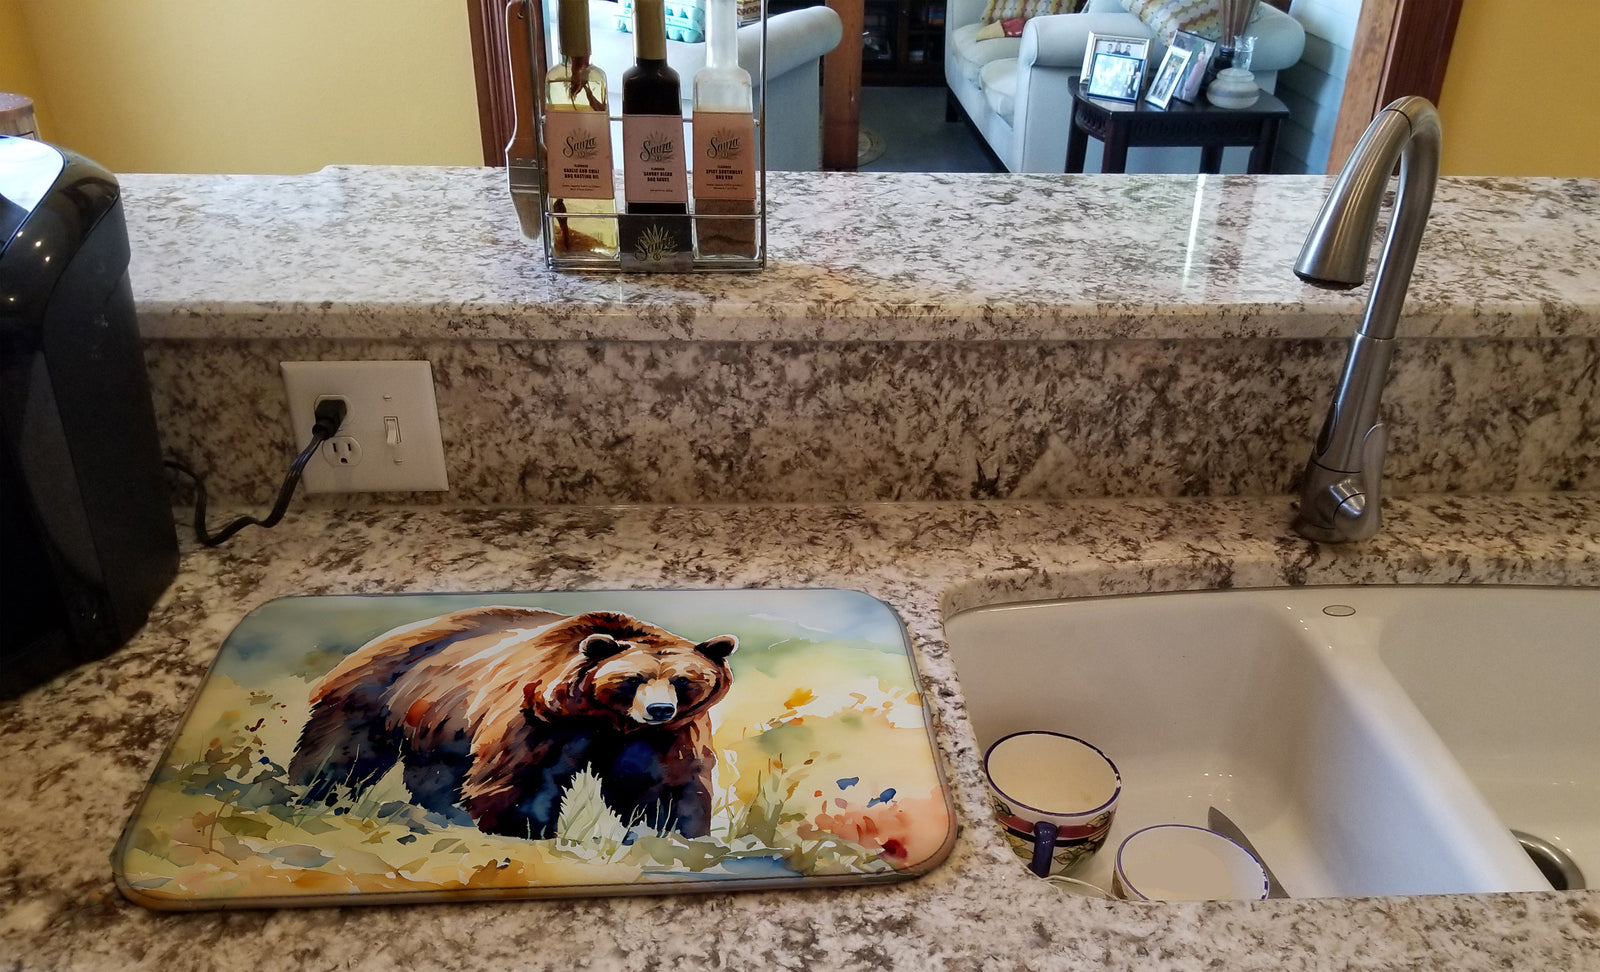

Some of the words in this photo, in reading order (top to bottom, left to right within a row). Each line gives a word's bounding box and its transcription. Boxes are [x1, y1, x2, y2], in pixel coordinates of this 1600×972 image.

[563, 136, 596, 158] Sauza
[640, 140, 673, 162] Sauza
[707, 137, 740, 159] Sauza
